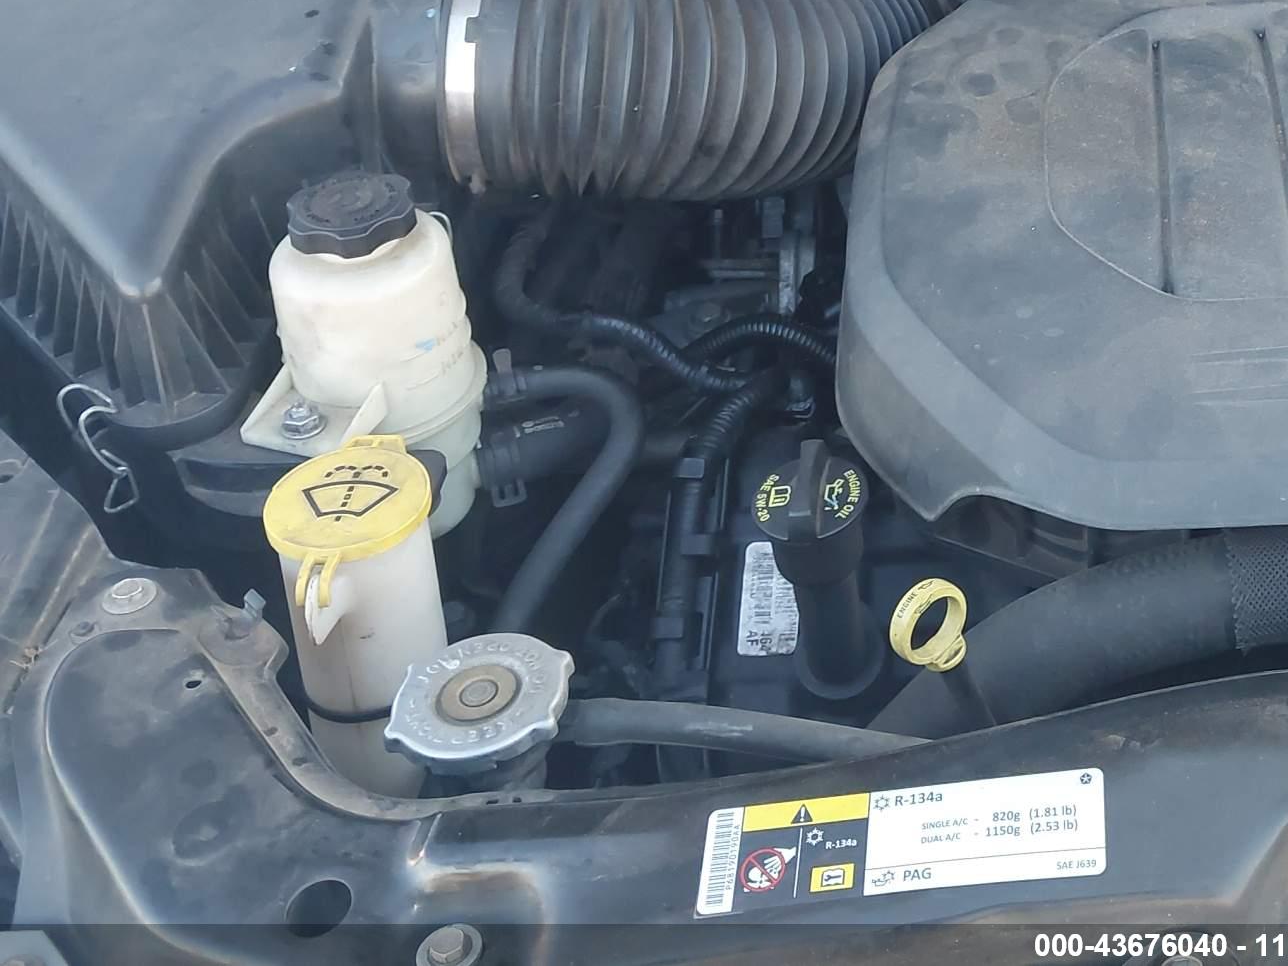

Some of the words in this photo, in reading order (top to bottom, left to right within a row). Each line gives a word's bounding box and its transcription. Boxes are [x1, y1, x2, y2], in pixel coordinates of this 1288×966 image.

[760, 474, 779, 492] SAE
[843, 469, 861, 503] ENGINE
[834, 504, 854, 519] OIL
[897, 592, 917, 618] ENGINE
[894, 791, 943, 807] R-134a
[921, 819, 951, 830] SINGLE
[952, 817, 969, 827] A/C
[992, 810, 1021, 823] 820g
[1029, 807, 1058, 820] (1.81
[1061, 804, 1077, 817] lb)
[920, 834, 944, 844] DUAL
[945, 832, 961, 842] A/C
[985, 825, 1021, 837] 1150g
[1030, 822, 1060, 835] (2.53
[1062, 819, 1078, 831] lb)
[825, 838, 858, 850] R-134a
[1057, 860, 1074, 870] SAE
[1075, 859, 1097, 869] J639
[903, 867, 932, 882] PAG
